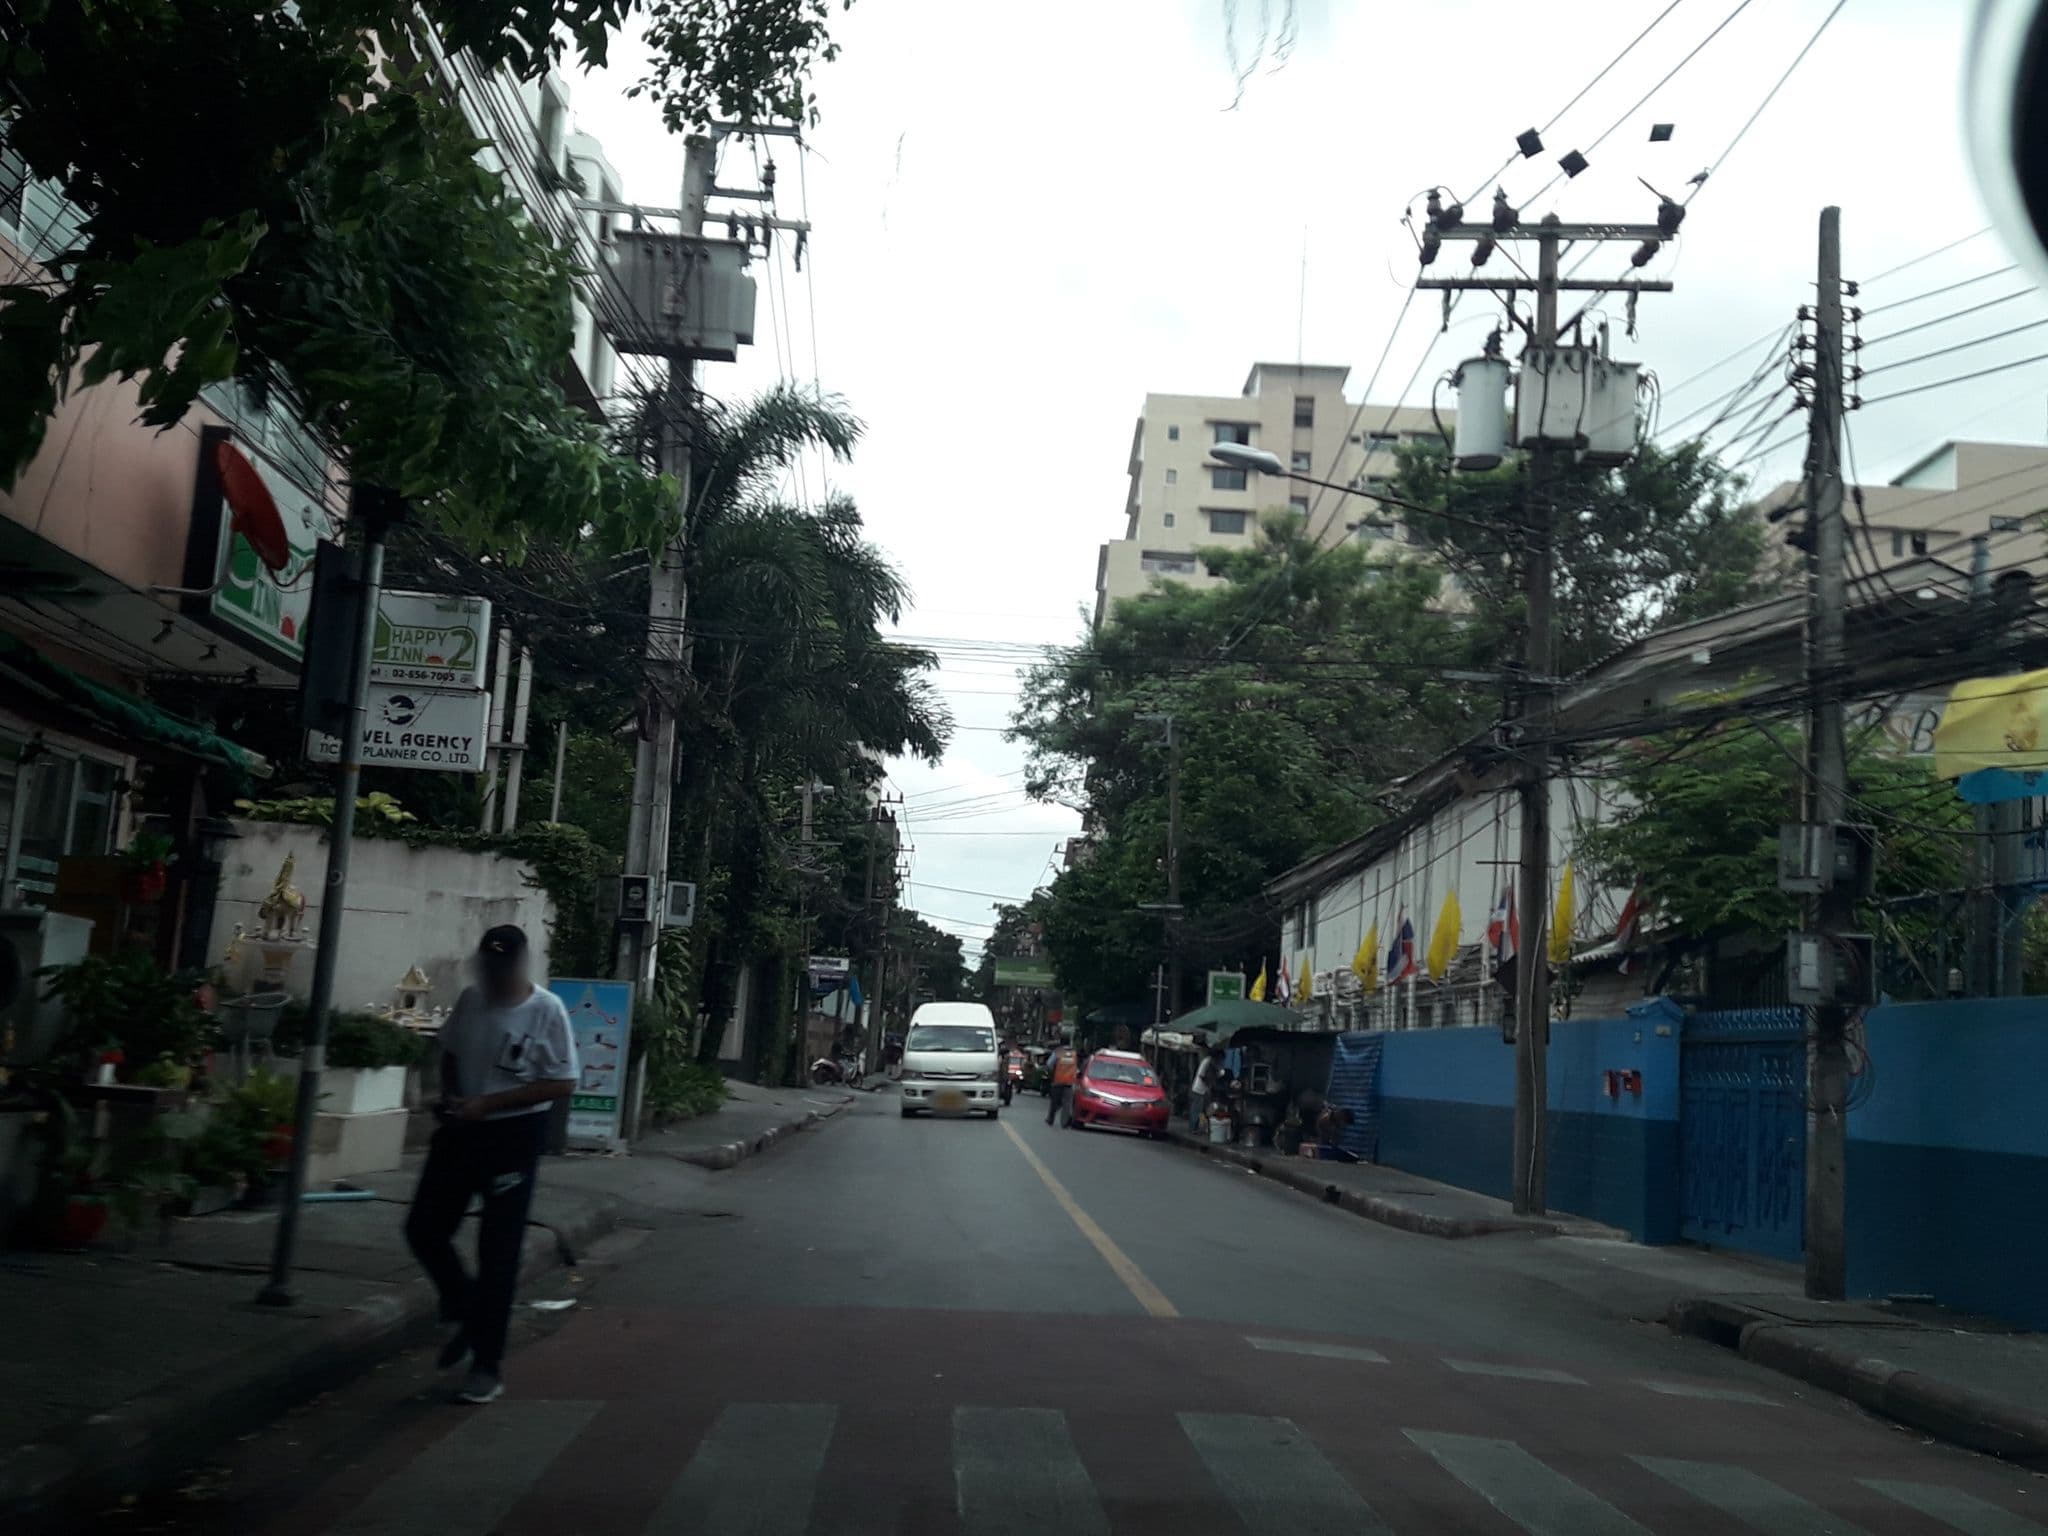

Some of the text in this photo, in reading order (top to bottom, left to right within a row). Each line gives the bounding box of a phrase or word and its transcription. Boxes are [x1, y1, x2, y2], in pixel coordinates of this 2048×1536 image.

[389, 645, 423, 663] INN
[391, 629, 474, 668] HAPPY 2
[400, 732, 473, 751] AGENCY
[362, 745, 418, 760] PLANNER
